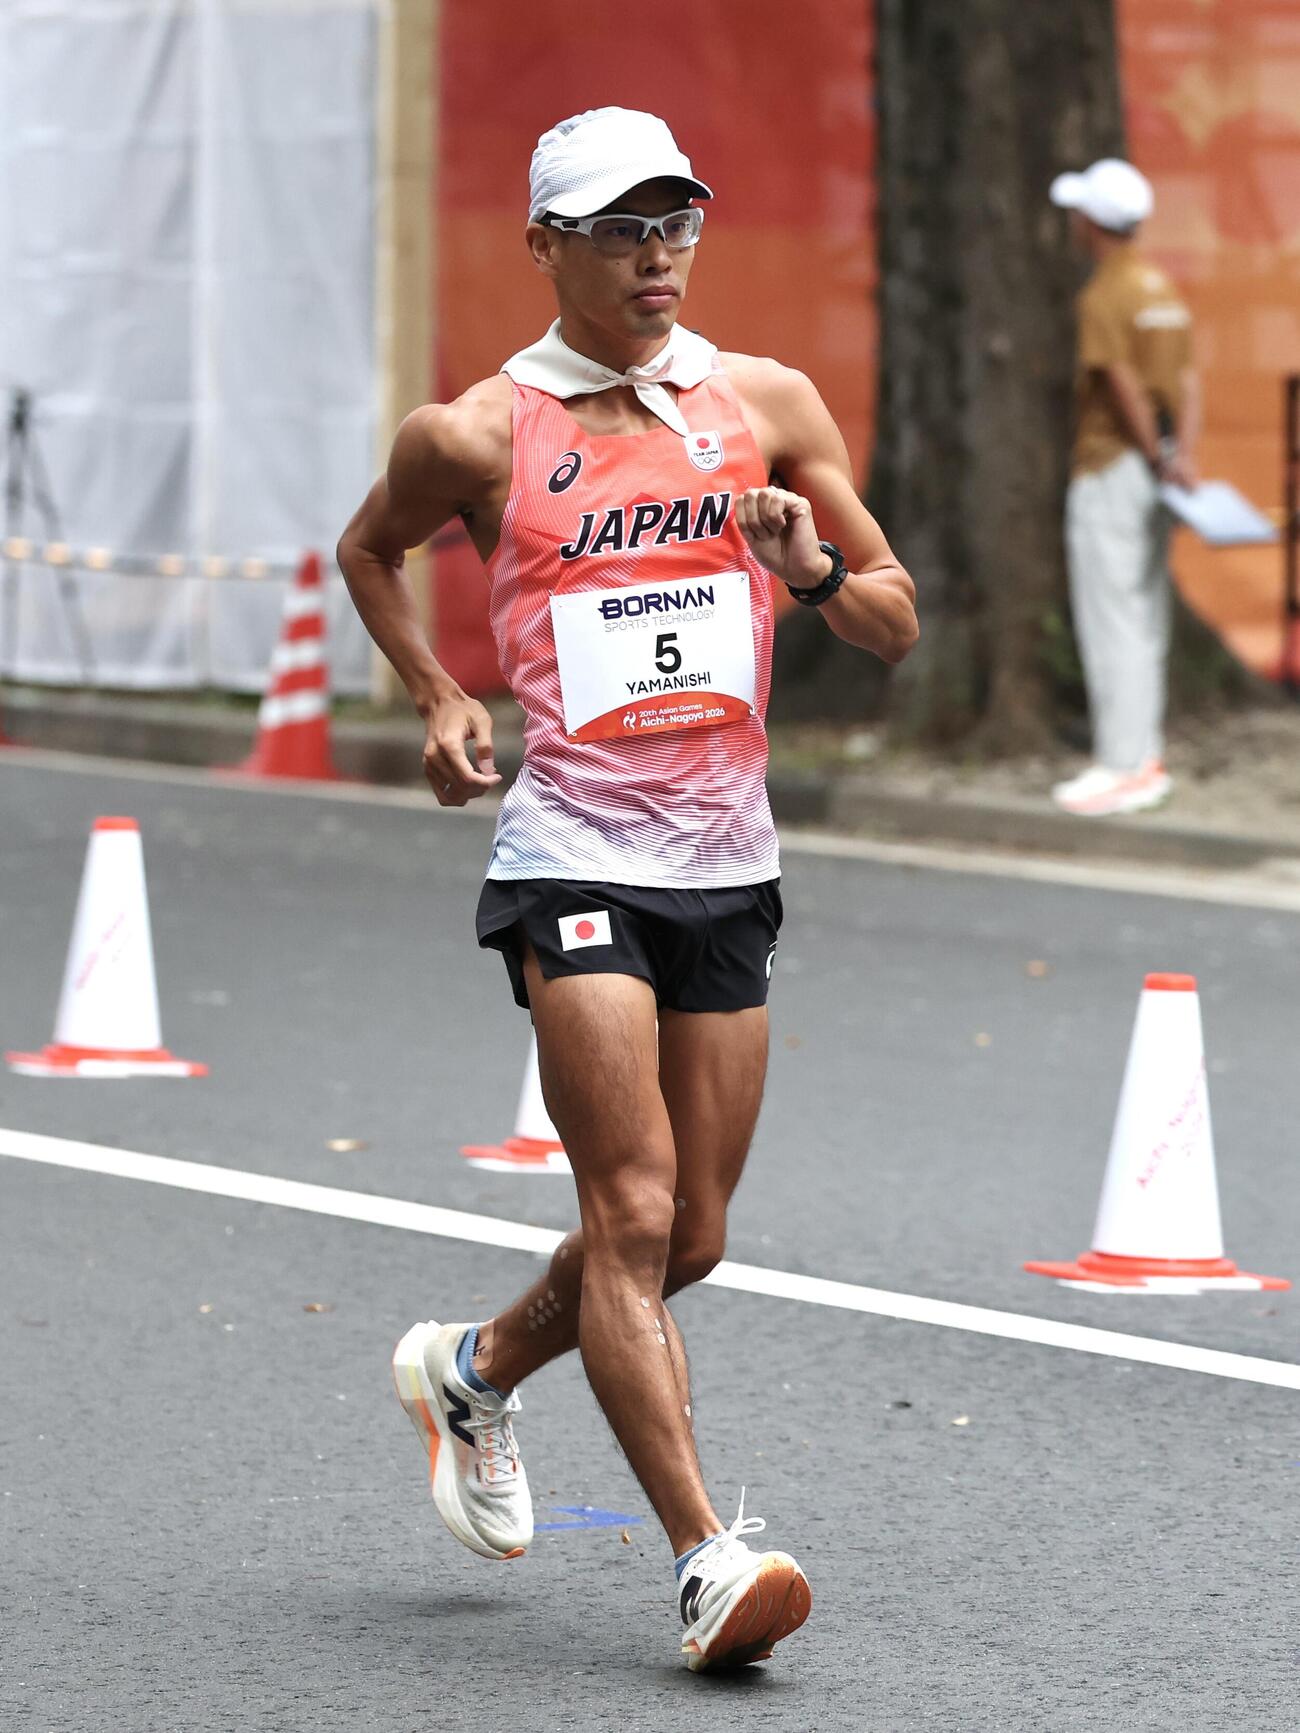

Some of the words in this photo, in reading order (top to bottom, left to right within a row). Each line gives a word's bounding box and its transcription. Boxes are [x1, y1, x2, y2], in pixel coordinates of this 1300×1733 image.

[560, 493, 731, 560] JAPAN
[597, 585, 715, 620] BORNAN
[604, 618, 649, 633] SPORTS
[652, 609, 716, 626] TECHNOLOGY
[655, 632, 682, 674] 5
[626, 671, 711, 695] YAMANISHI
[639, 708, 657, 717] 20th
[658, 706, 679, 716] Asian
[679, 703, 703, 713] Games
[640, 710, 704, 728] Aichi-Nagoya
[705, 707, 725, 719] 2026
